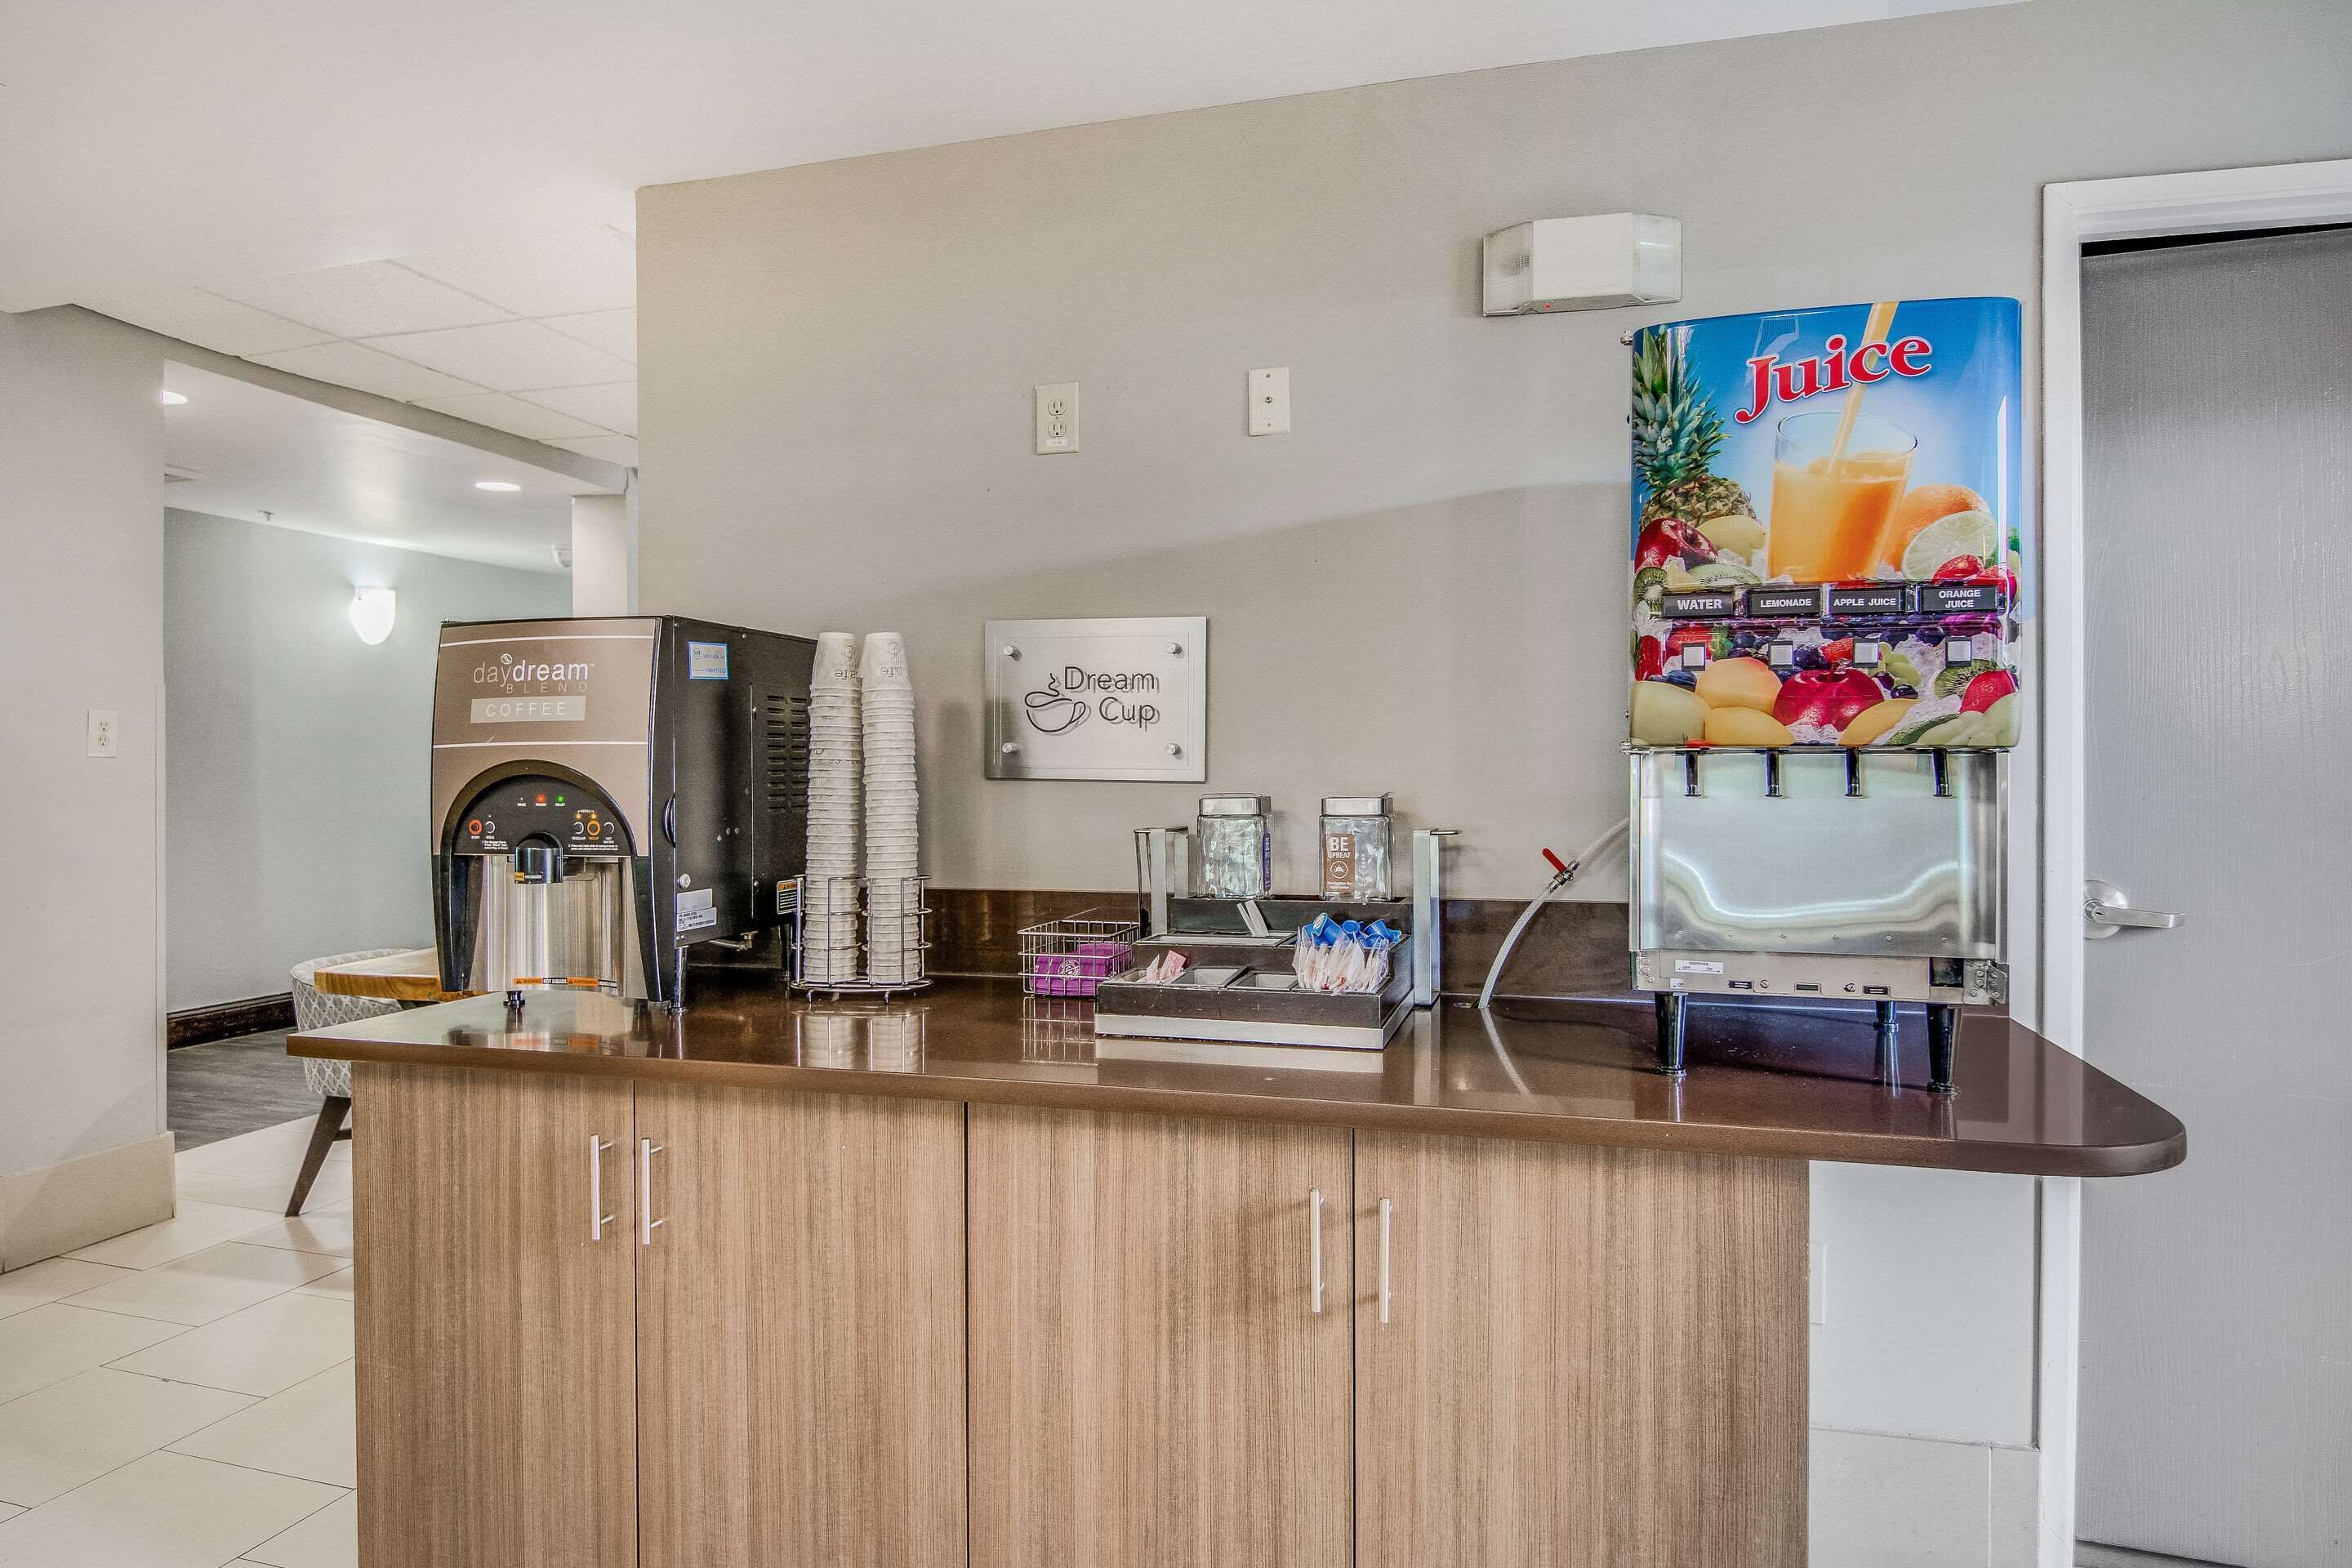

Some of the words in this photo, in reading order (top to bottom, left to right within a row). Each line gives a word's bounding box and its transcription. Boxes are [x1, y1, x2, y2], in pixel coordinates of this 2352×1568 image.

[1734, 333, 1932, 424] Juice
[1938, 589, 1981, 599] ORANGE
[1677, 599, 1722, 610] WATER
[1760, 598, 1812, 608] LEMONADE
[1833, 598, 1864, 607] APPLE
[1868, 598, 1896, 607] JUICE
[1944, 599, 1974, 608] JUICE
[473, 659, 589, 688] daydream
[1064, 666, 1156, 691] Dream
[506, 682, 588, 694] BLEND
[486, 702, 567, 717] COFFEE
[1098, 696, 1156, 728] Cup
[1330, 836, 1349, 852] BE
